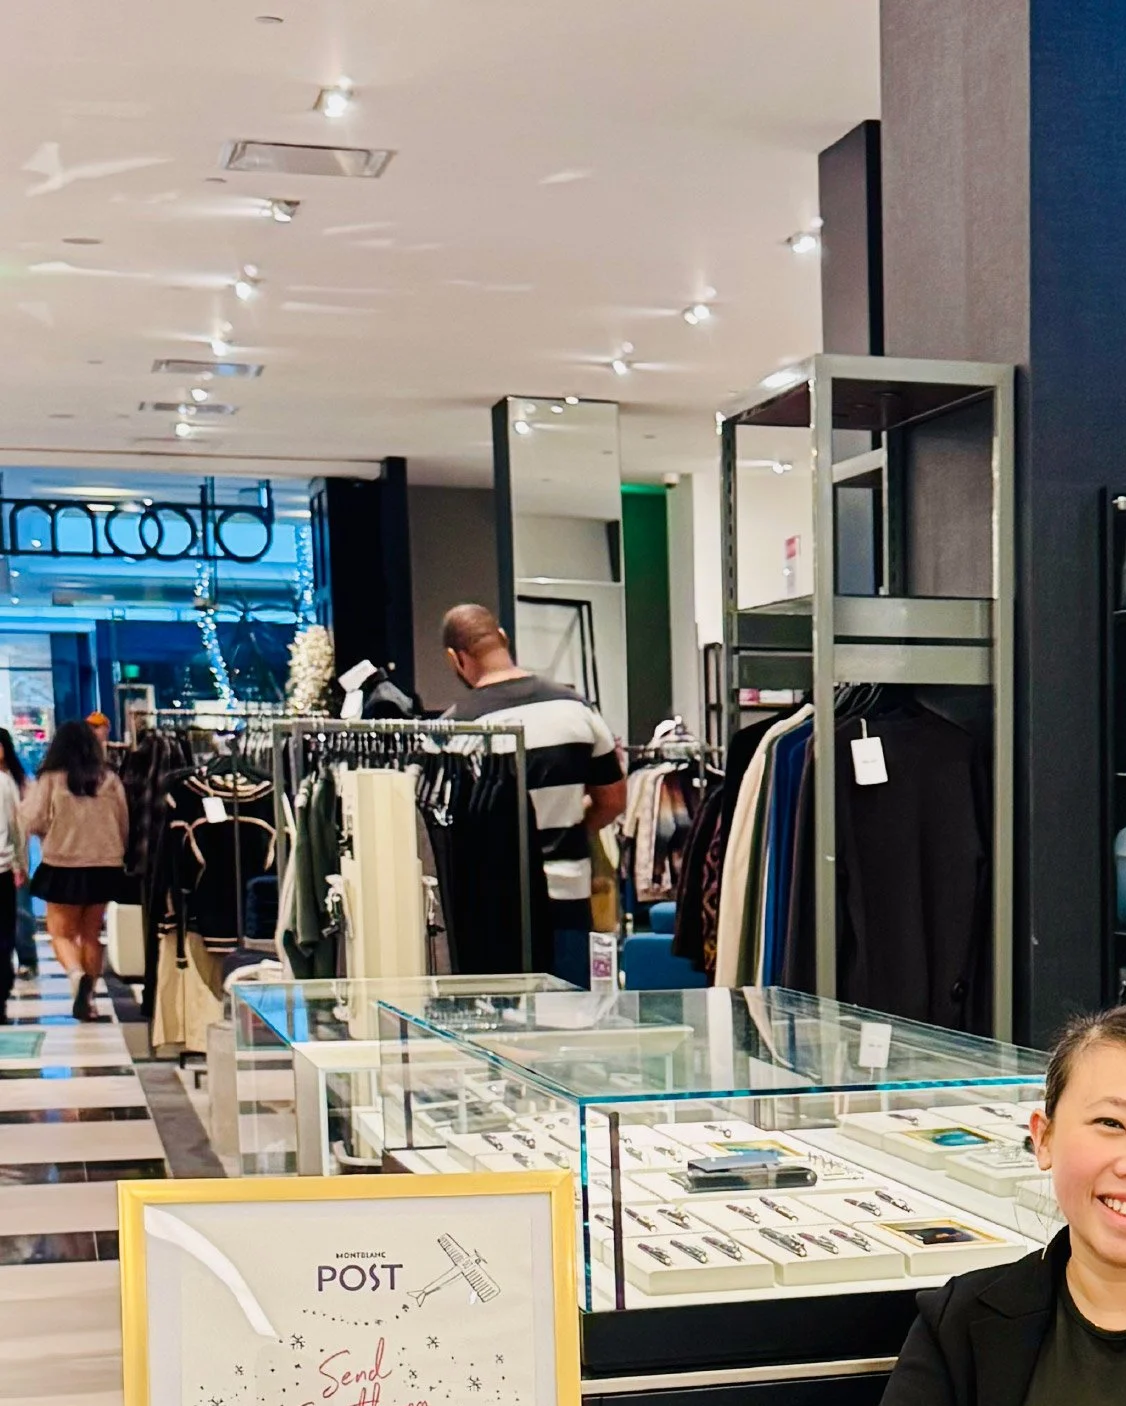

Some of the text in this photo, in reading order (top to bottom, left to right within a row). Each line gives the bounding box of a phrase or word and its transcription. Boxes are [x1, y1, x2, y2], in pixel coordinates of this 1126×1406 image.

[335, 1251, 386, 1259] MONTBLANC
[317, 1263, 404, 1292] POST
[319, 1337, 393, 1399] Send
